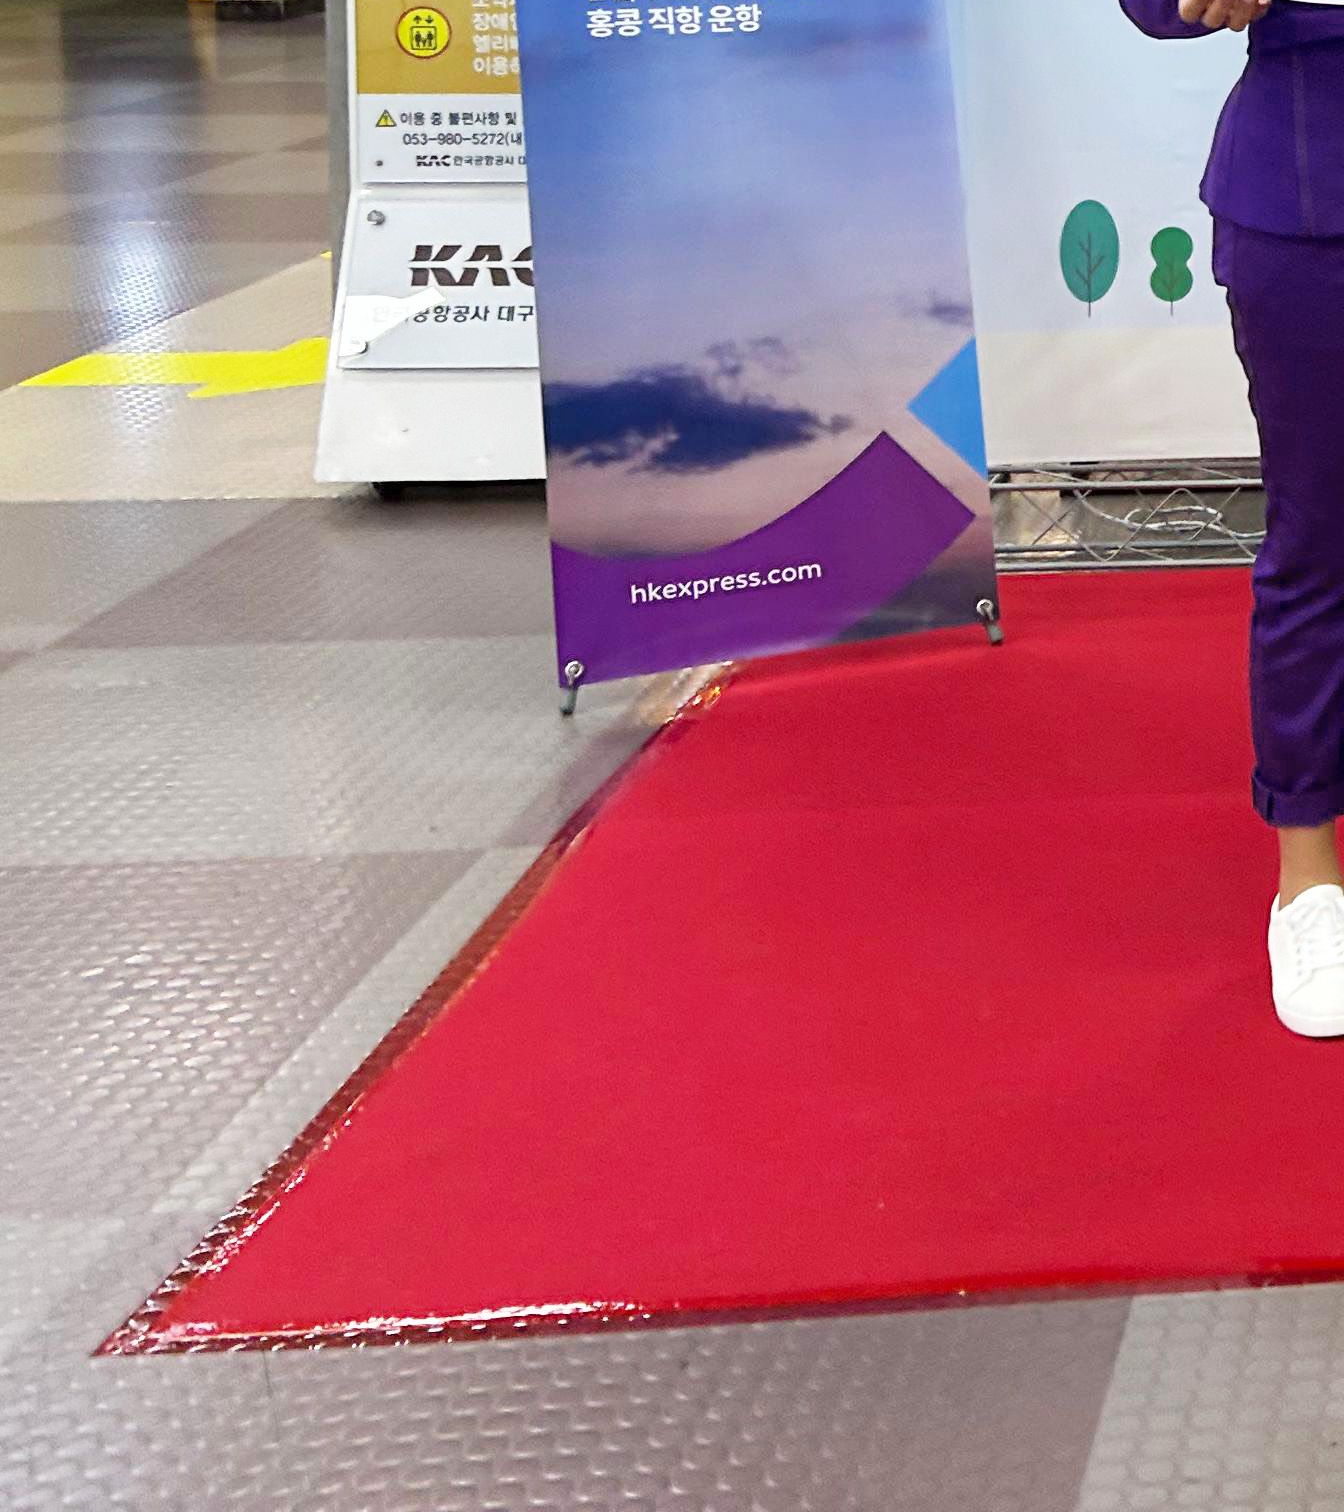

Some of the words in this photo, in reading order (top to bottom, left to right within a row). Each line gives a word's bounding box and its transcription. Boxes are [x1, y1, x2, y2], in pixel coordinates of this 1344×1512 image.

[586, 8, 643, 38] 홍콩
[648, 5, 702, 35] 직항
[708, 3, 762, 33] 운항
[400, 112, 426, 126] 이용
[431, 112, 443, 126] 중
[449, 112, 500, 126] 불편사항
[504, 112, 517, 126] 및
[416, 155, 451, 167] KAC
[498, 305, 534, 322] 대구
[630, 562, 822, 604] hkexpress.com
